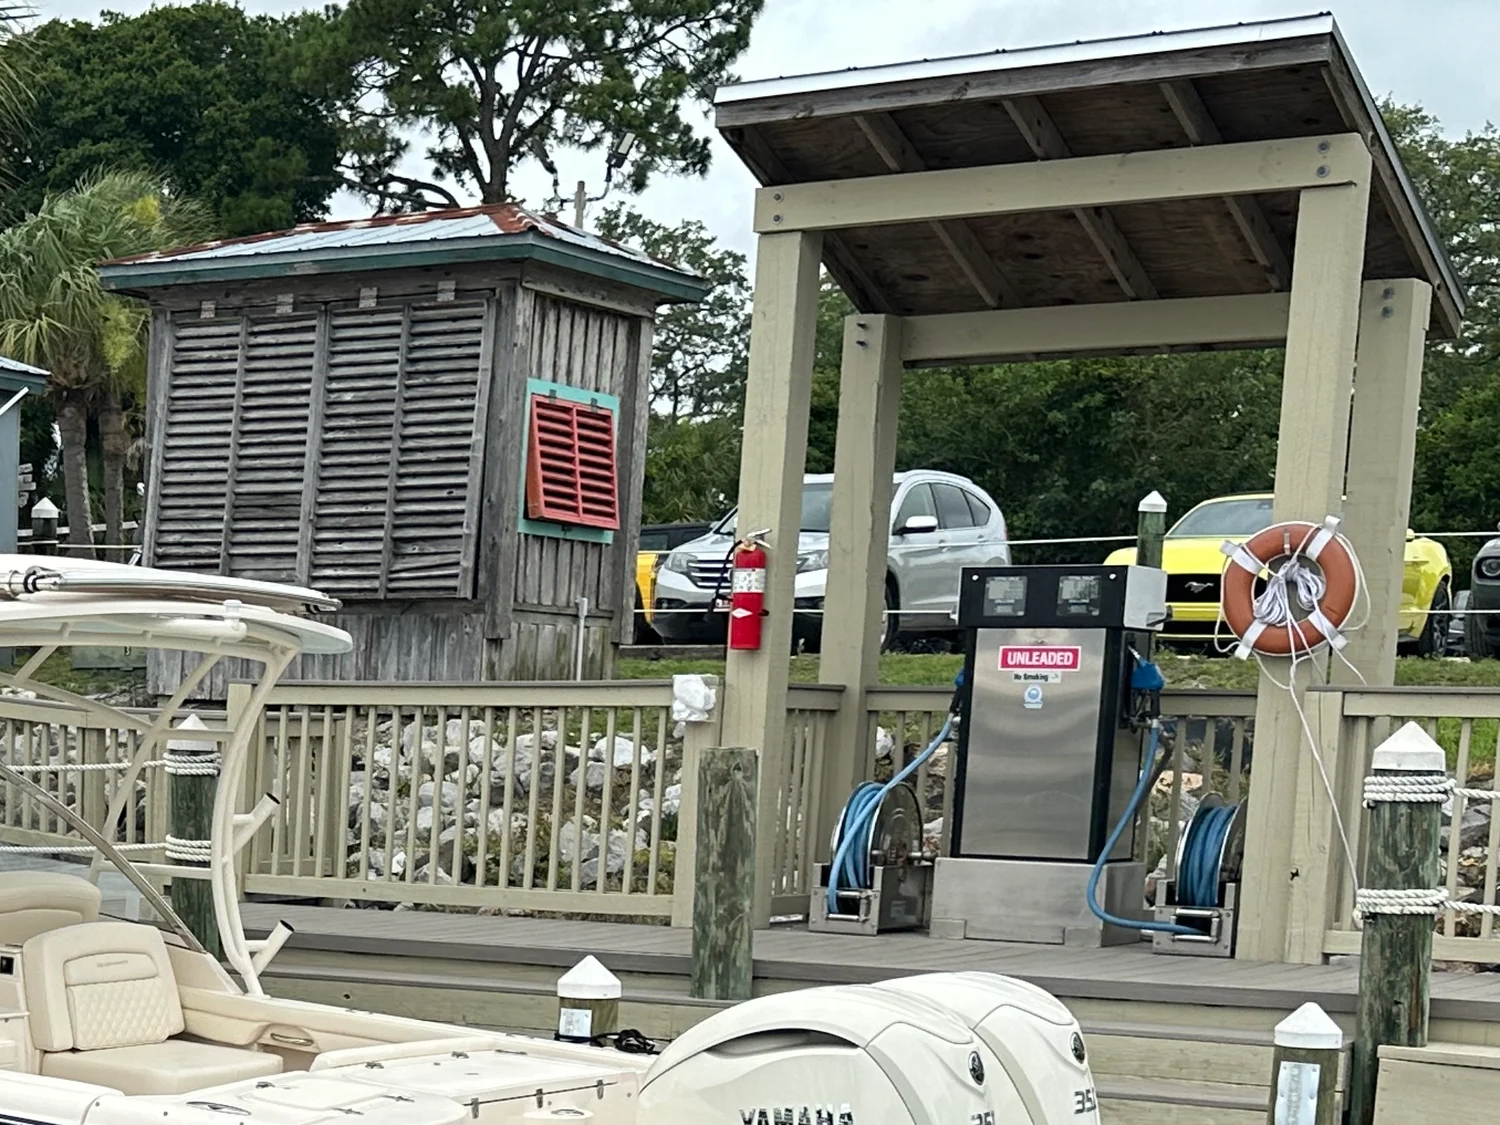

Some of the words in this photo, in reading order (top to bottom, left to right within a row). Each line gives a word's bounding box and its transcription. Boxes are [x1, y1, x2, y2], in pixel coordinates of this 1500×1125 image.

[1007, 651, 1074, 666] UNLEADED
[1013, 673, 1022, 681] No
[1023, 673, 1049, 682] Smoking
